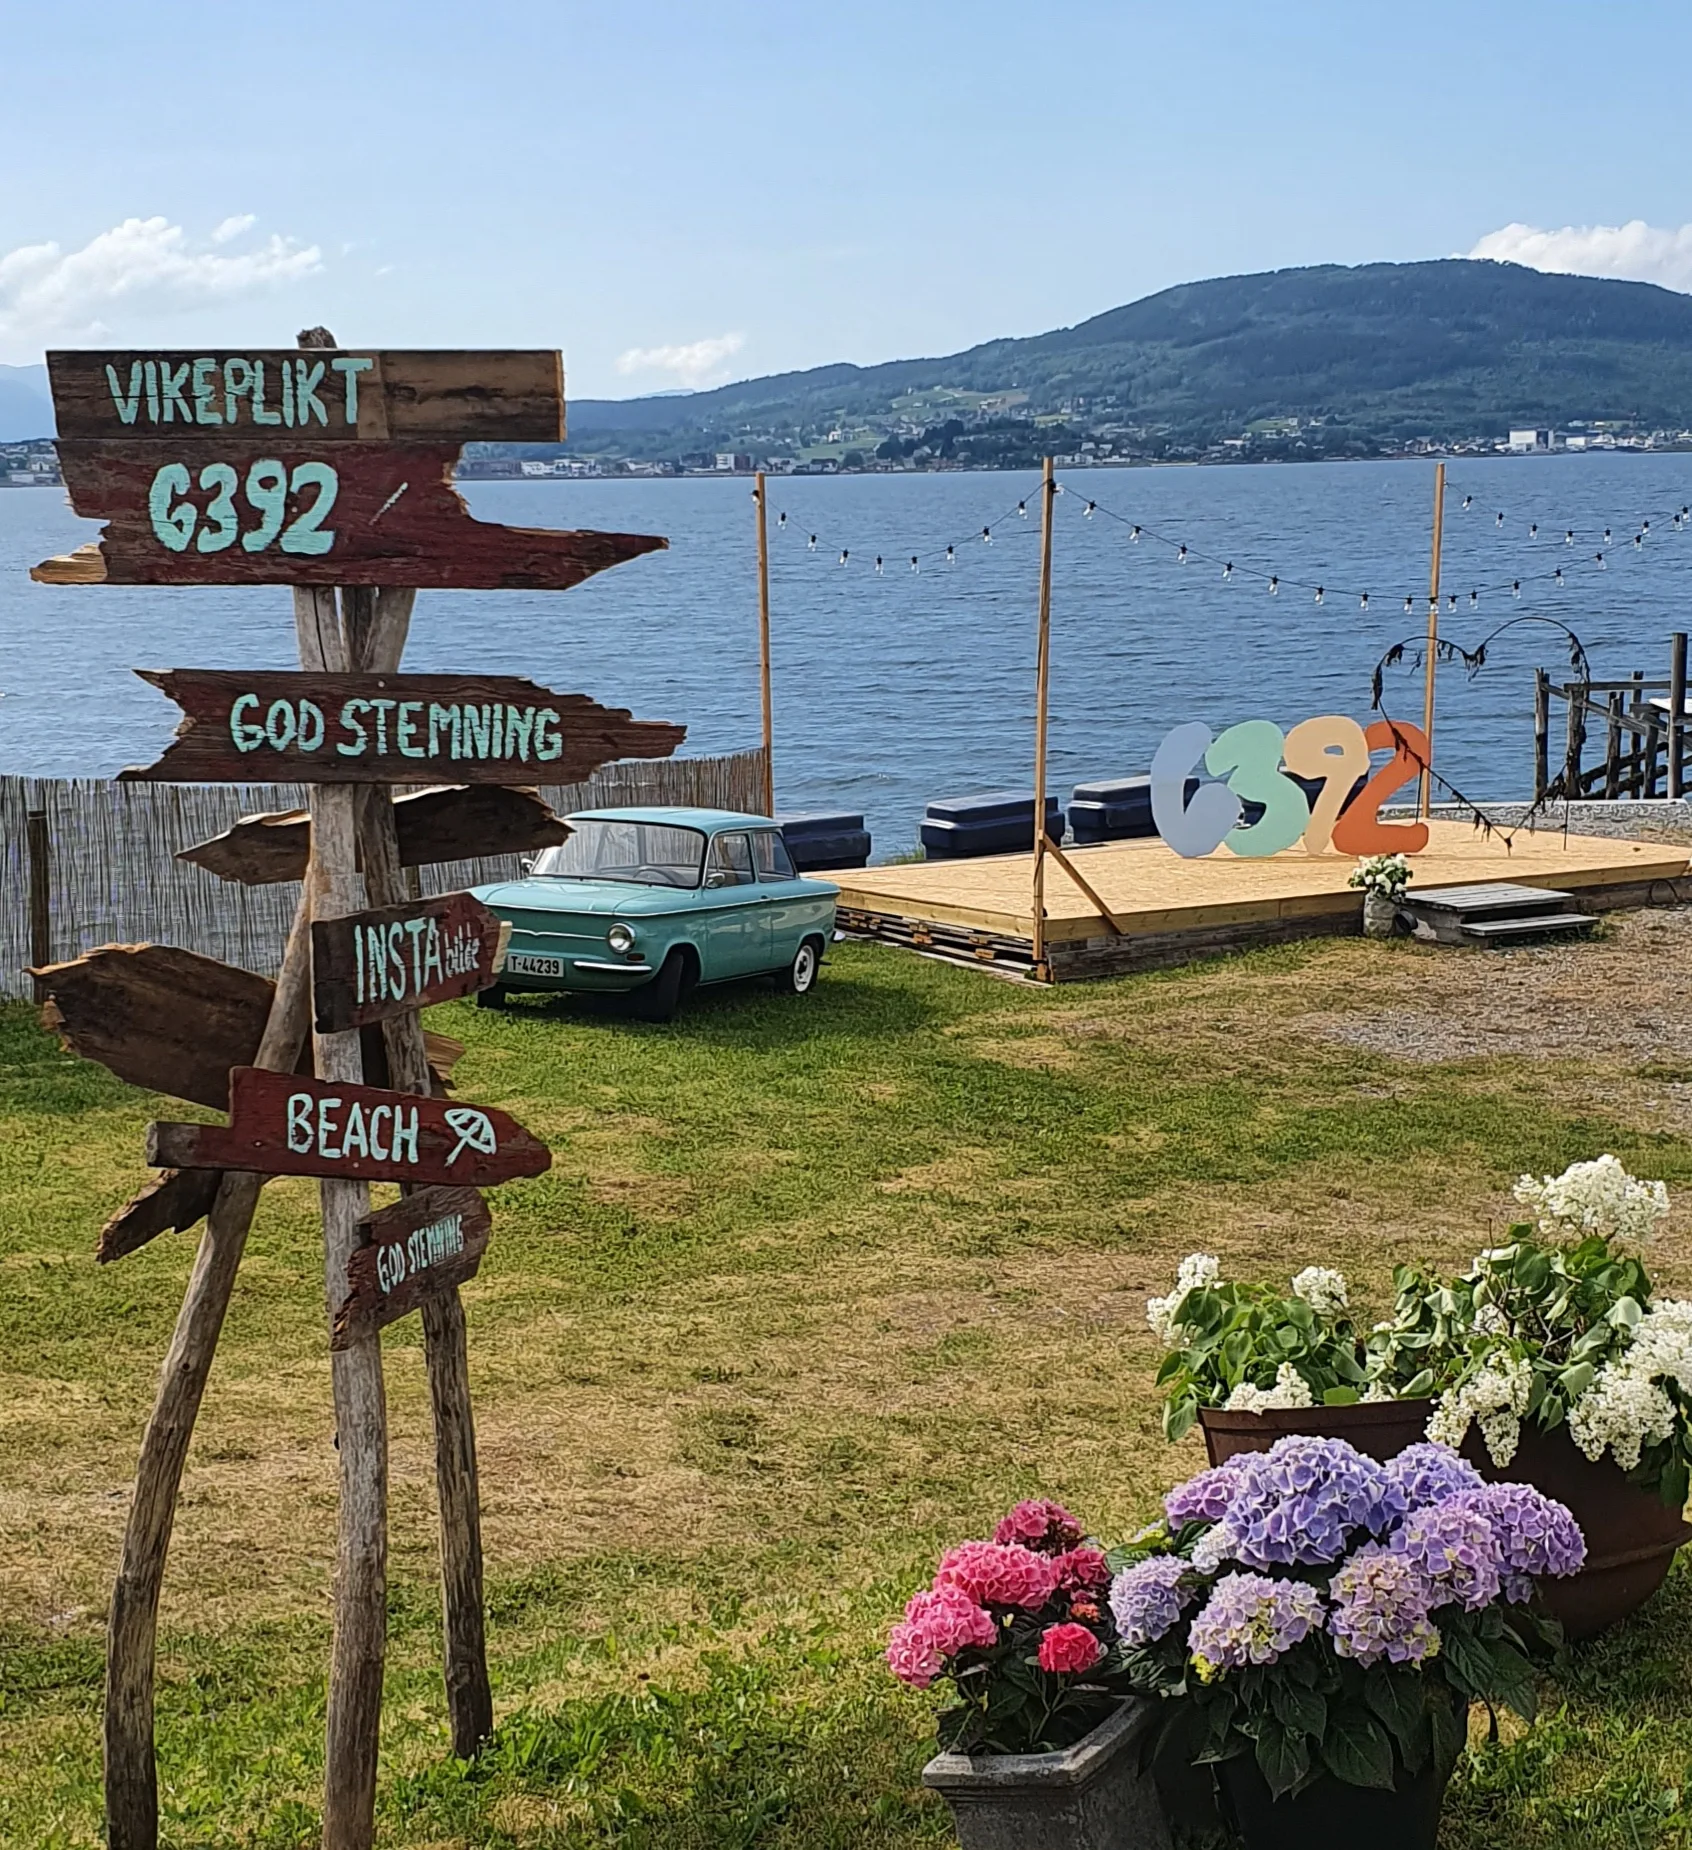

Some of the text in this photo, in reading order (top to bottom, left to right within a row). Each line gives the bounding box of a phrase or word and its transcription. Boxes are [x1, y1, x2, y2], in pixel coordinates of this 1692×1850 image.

[105, 357, 373, 428] VIKEPLIKT
[148, 458, 339, 555] 6392
[229, 692, 562, 761] GOD STEMNING
[1150, 715, 1431, 858] 6392
[511, 956, 560, 975] T-44239
[287, 1093, 419, 1164] BEACH
[376, 1242, 406, 1295] GOD
